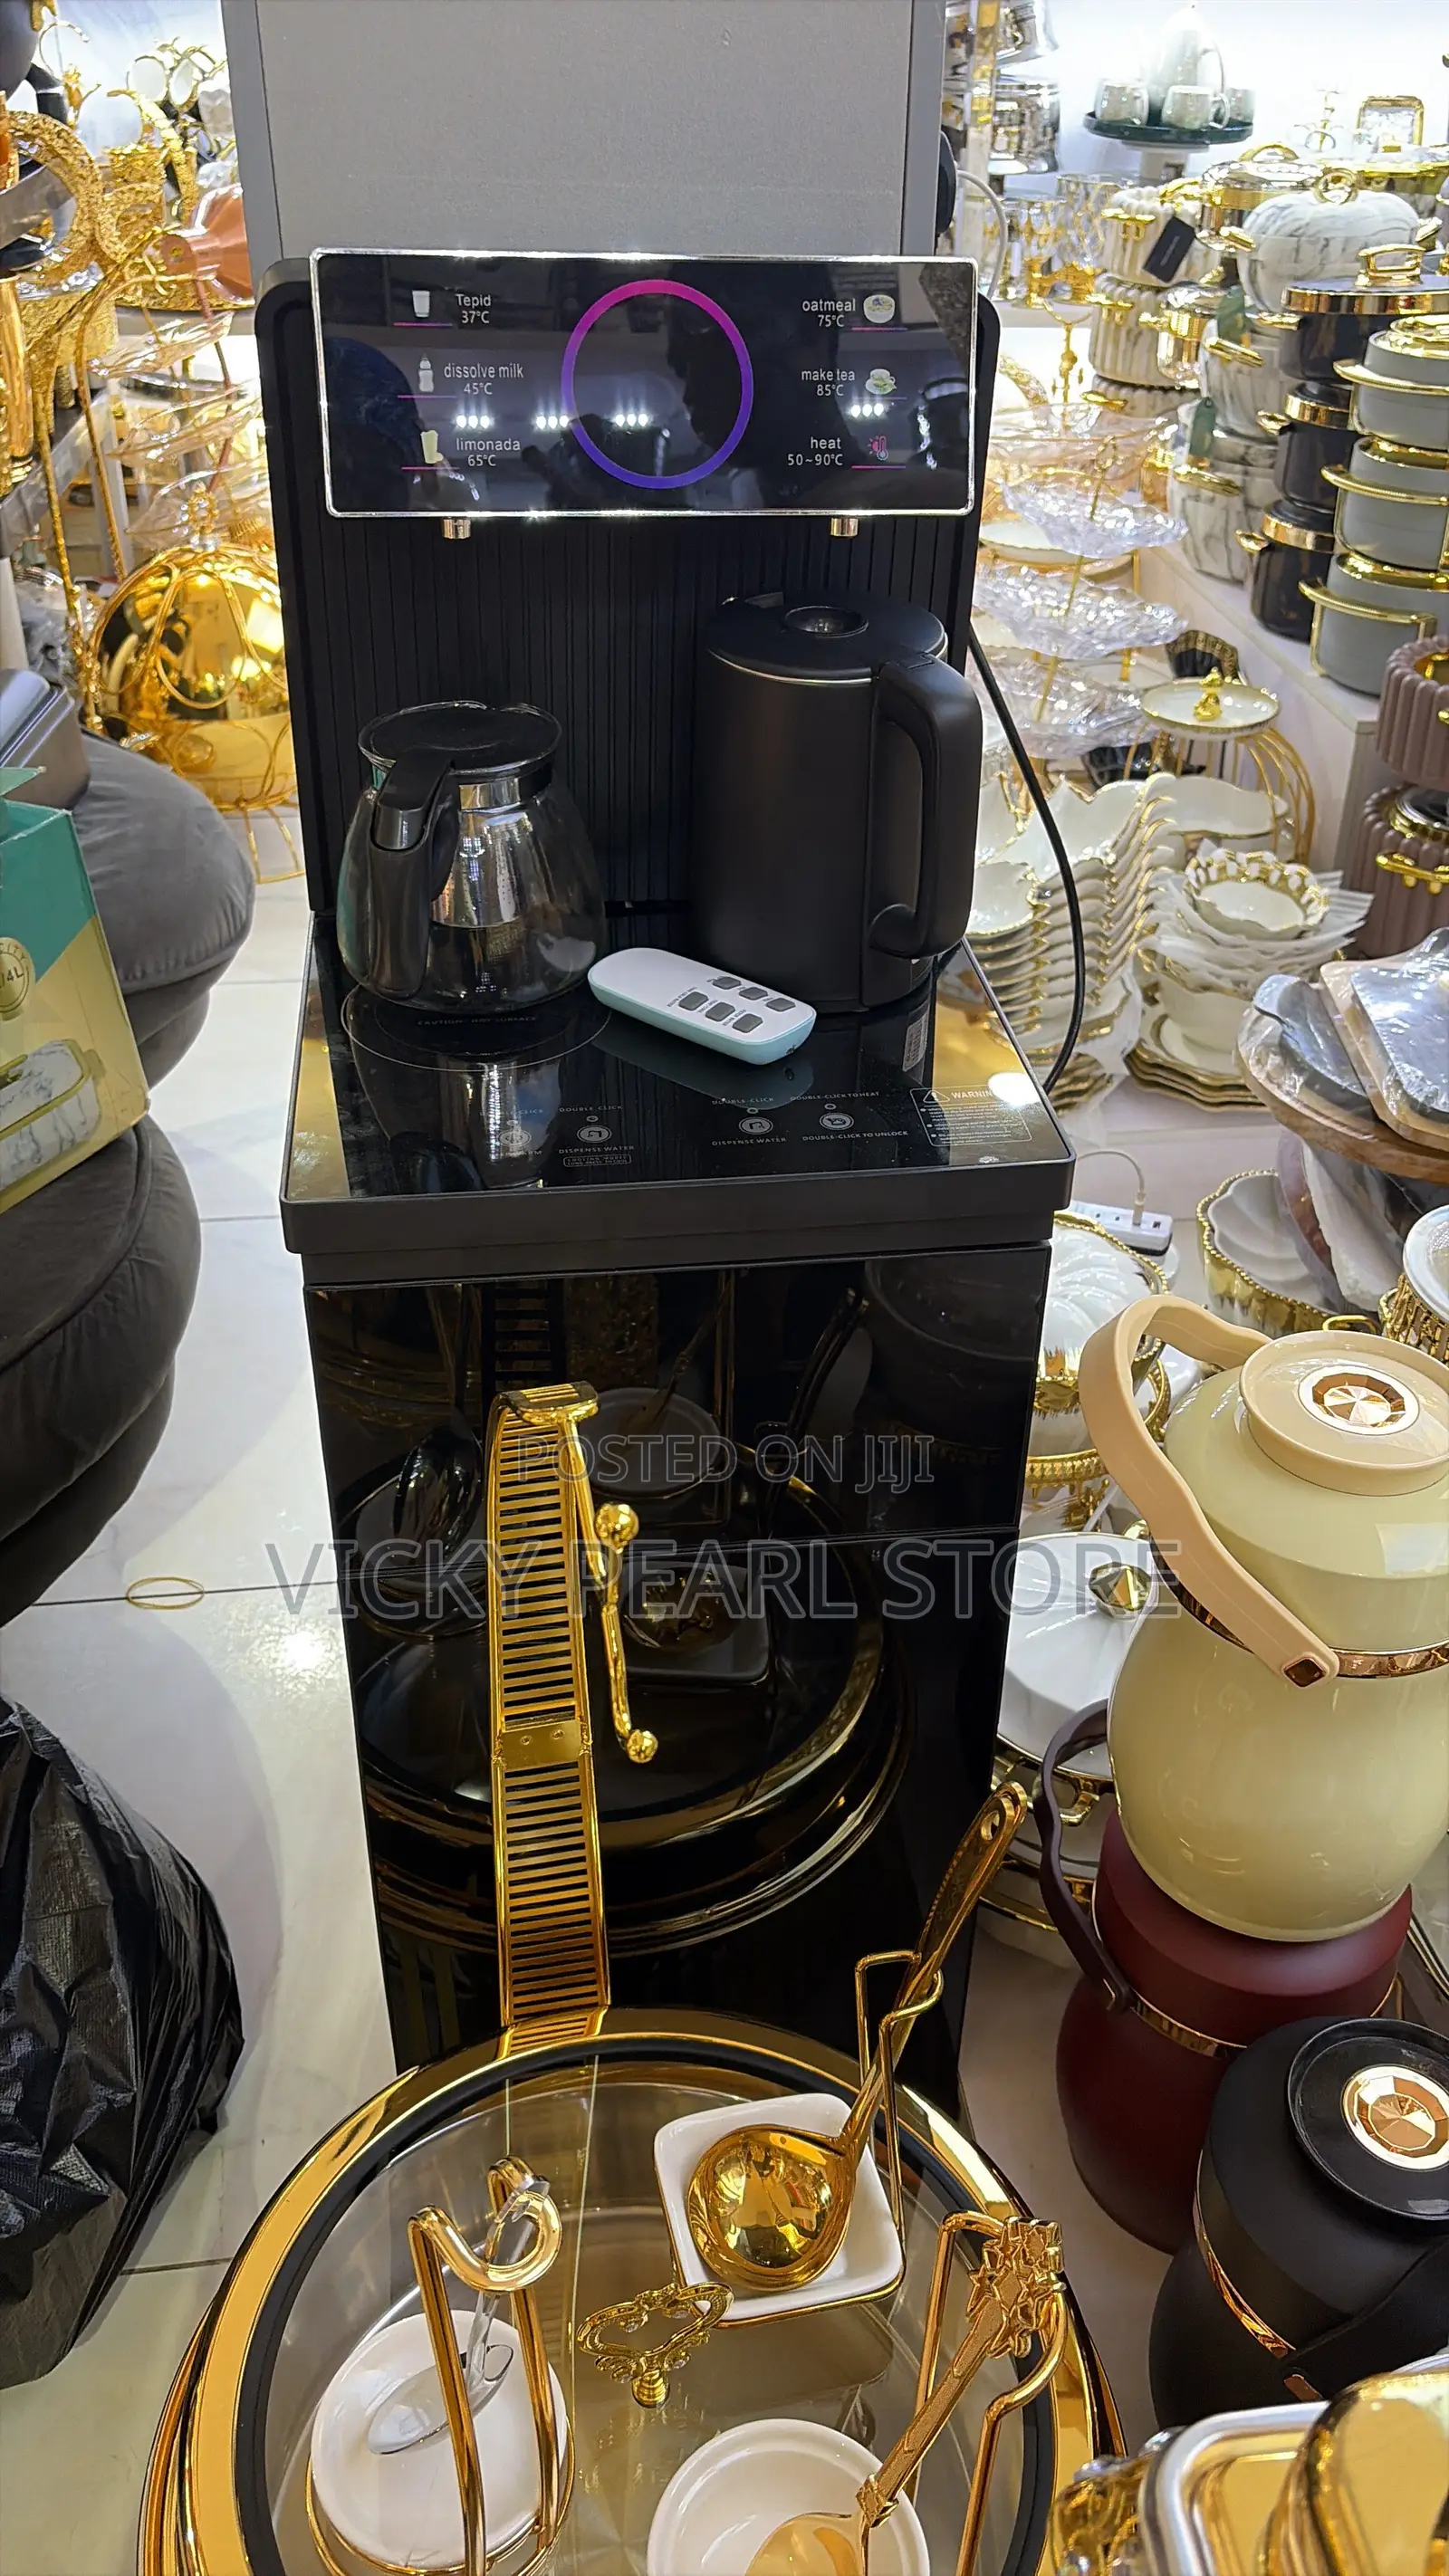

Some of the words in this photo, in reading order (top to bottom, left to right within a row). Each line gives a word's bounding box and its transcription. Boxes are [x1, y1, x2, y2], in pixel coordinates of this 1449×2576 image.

[456, 293, 492, 309] Tepid
[801, 298, 856, 312] oatmeal
[461, 310, 490, 324] 37°C
[817, 314, 845, 327] 75°C
[444, 363, 495, 378] dissolve
[498, 363, 524, 378] milk
[801, 368, 834, 381] make
[836, 369, 856, 381] tea
[463, 382, 494, 395] 45°C
[816, 384, 844, 397] 85°C
[456, 437, 521, 451] limonada
[810, 436, 841, 449] heat
[467, 454, 497, 466] 65°C
[951, 1089, 994, 1099] WARNIN
[712, 1137, 755, 1146] DISPENSE
[757, 1136, 787, 1144] WATER
[802, 1133, 861, 1142] DOUBLE-CLICK
